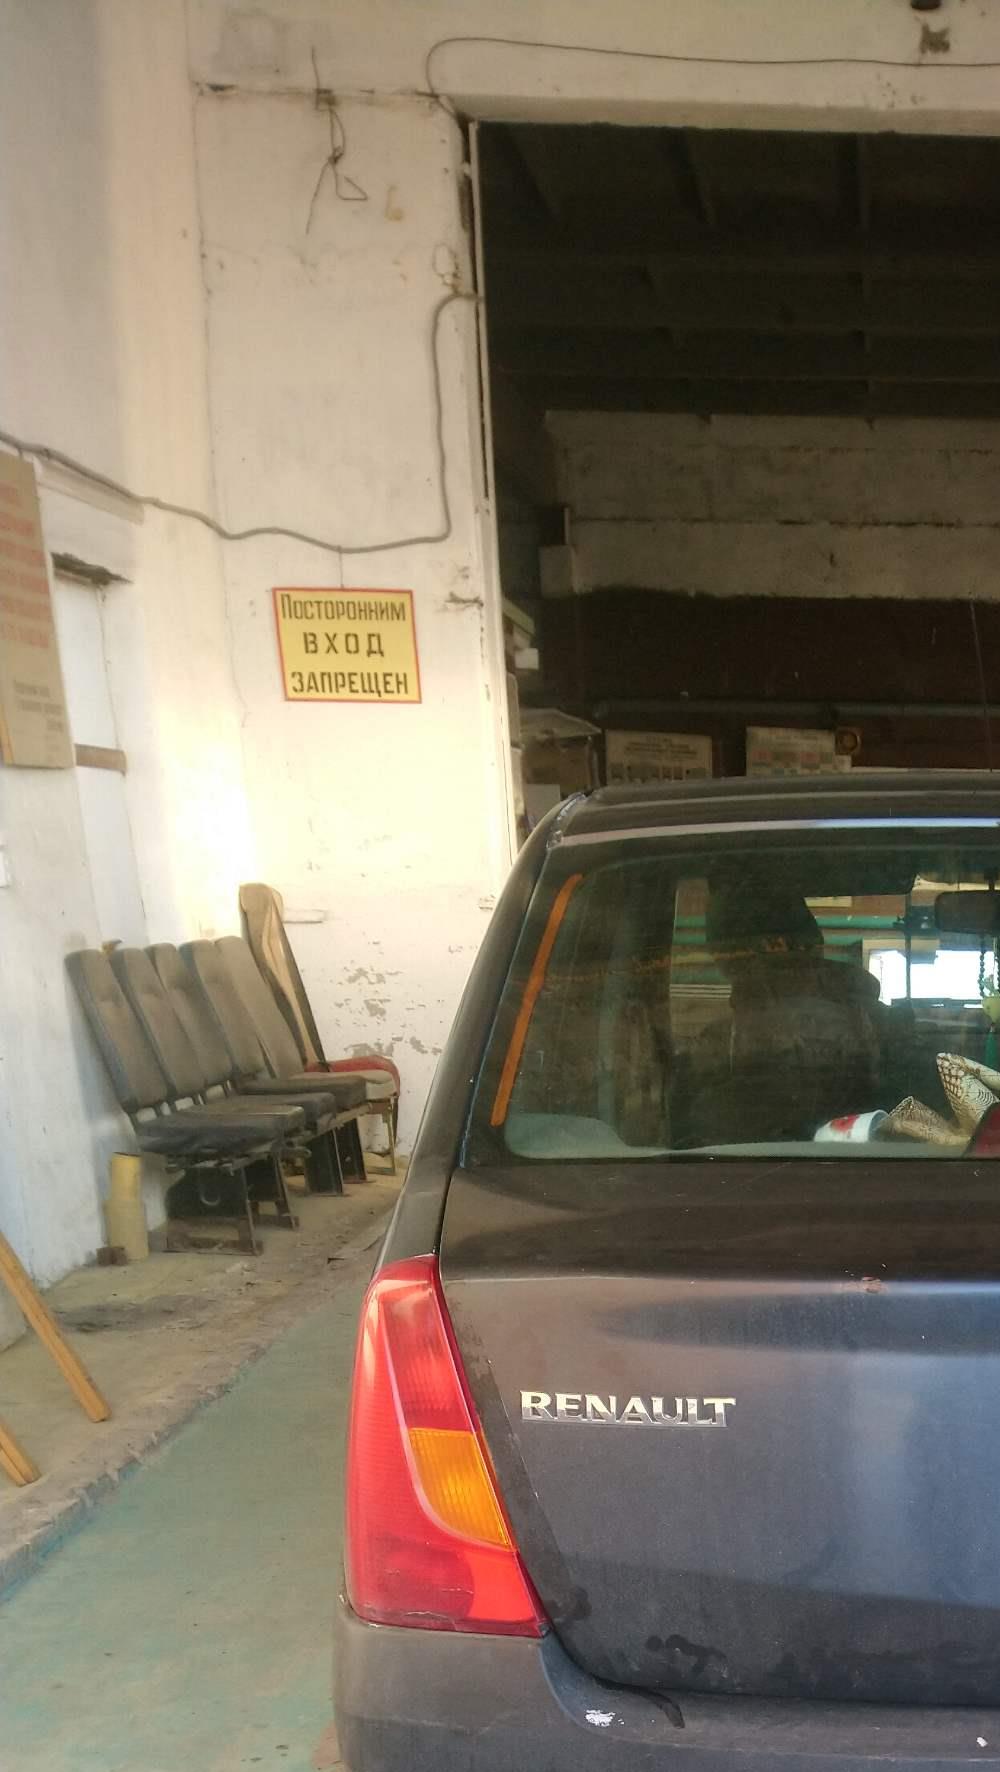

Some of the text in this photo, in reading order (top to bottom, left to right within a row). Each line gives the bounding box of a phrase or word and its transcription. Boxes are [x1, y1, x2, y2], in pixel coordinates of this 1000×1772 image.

[280, 593, 406, 622] ПОСТОРОННИМ
[303, 631, 385, 658] ВХОД
[291, 671, 408, 698] ЗАПРЕЩЕН
[520, 1390, 736, 1427] RENAULT
